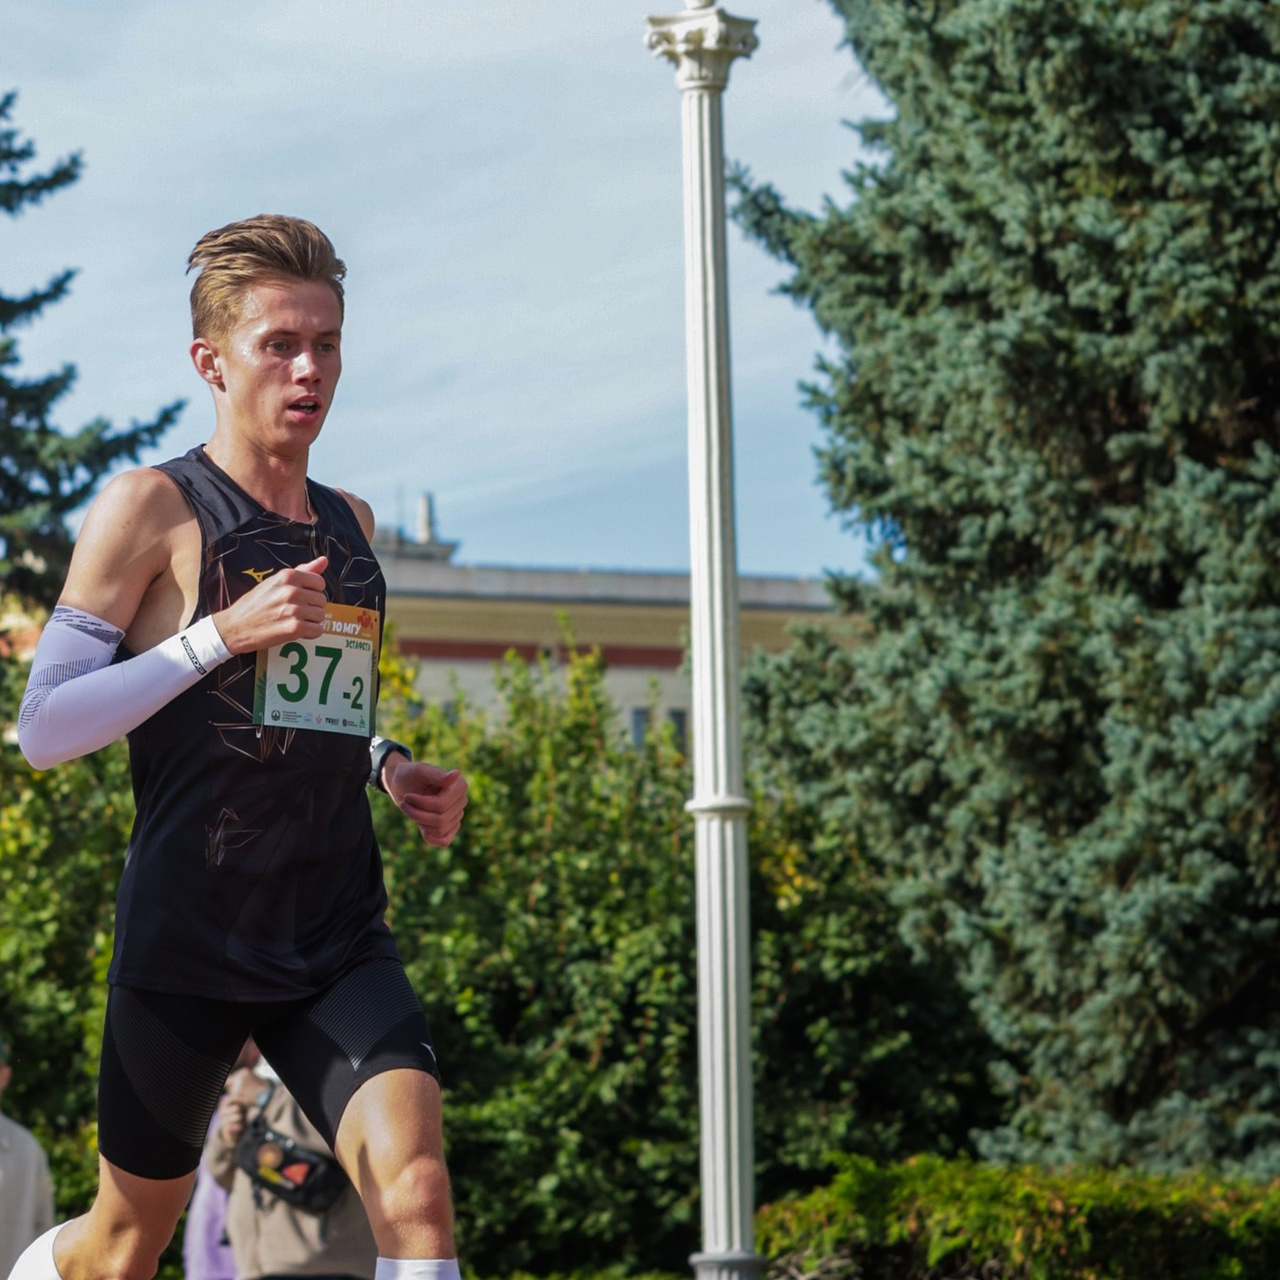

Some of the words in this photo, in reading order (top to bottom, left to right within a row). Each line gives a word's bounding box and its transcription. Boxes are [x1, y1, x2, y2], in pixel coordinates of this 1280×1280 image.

[343, 622, 361, 635] МГУ
[345, 639, 371, 651] ЭСТАФЕТА
[276, 641, 364, 710] 37-2
